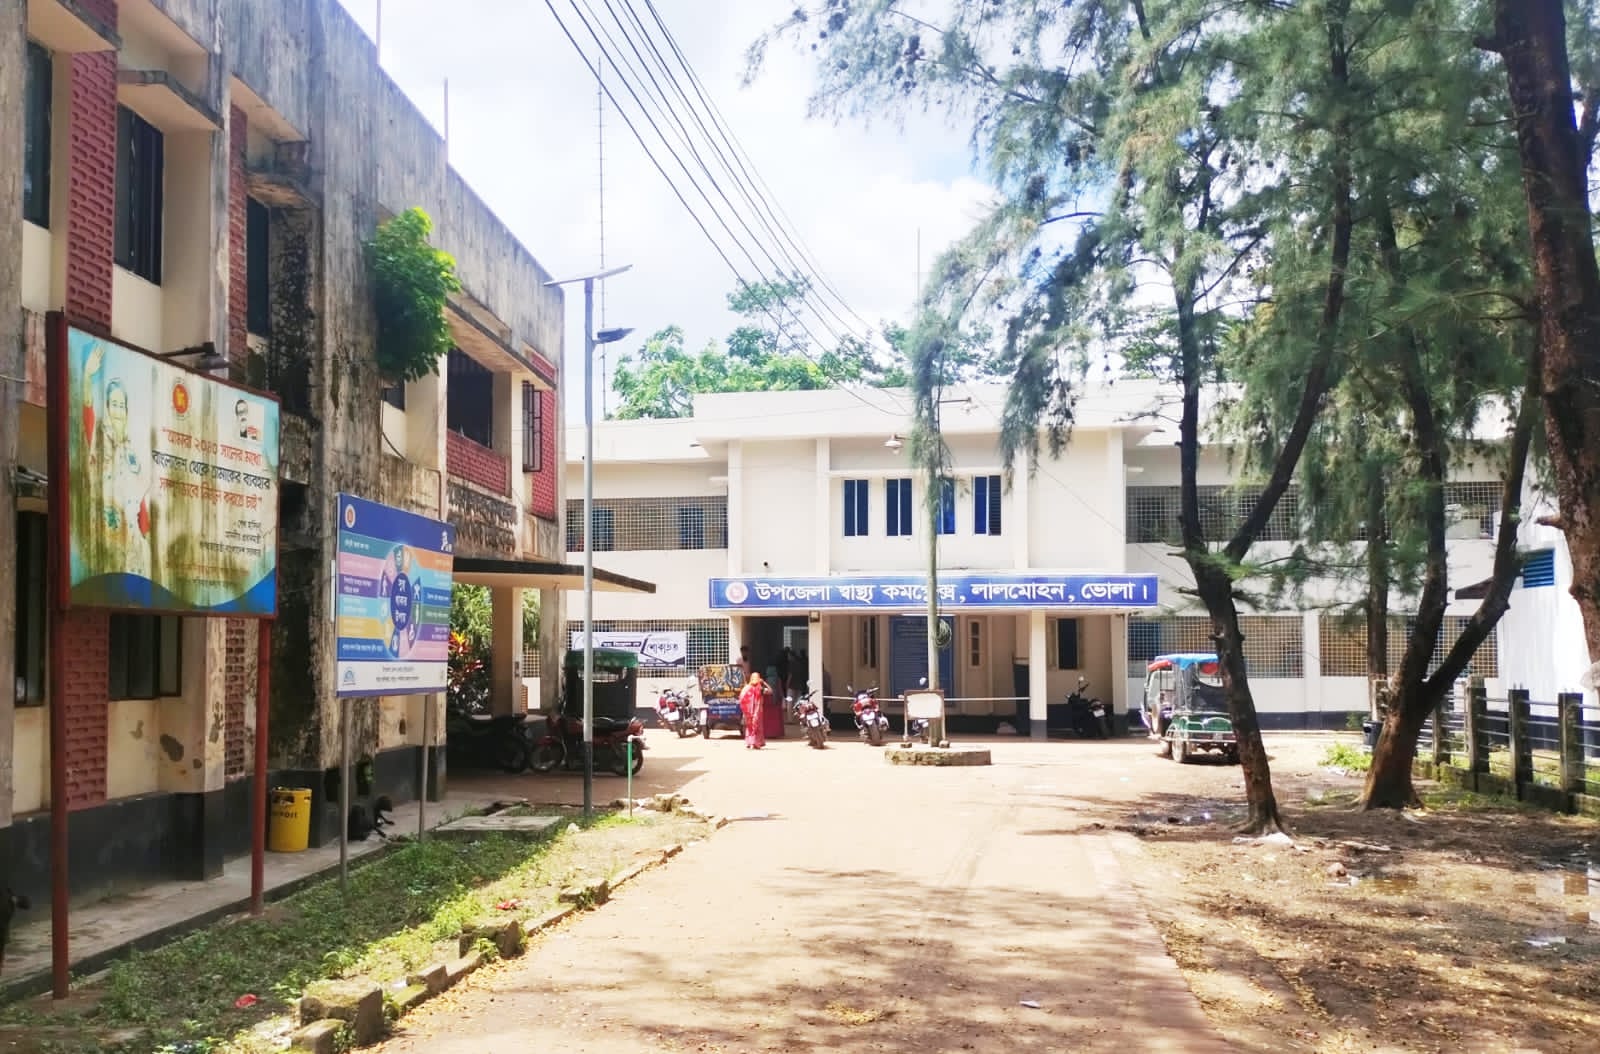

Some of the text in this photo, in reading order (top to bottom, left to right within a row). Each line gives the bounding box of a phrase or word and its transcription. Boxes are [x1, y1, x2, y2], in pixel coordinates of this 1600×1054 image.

[189, 460, 209, 475] থেকে
[243, 472, 270, 489] ব্যবহার
[754, 581, 830, 601] উপজেলা
[836, 584, 877, 604] স্বাস্থ্য
